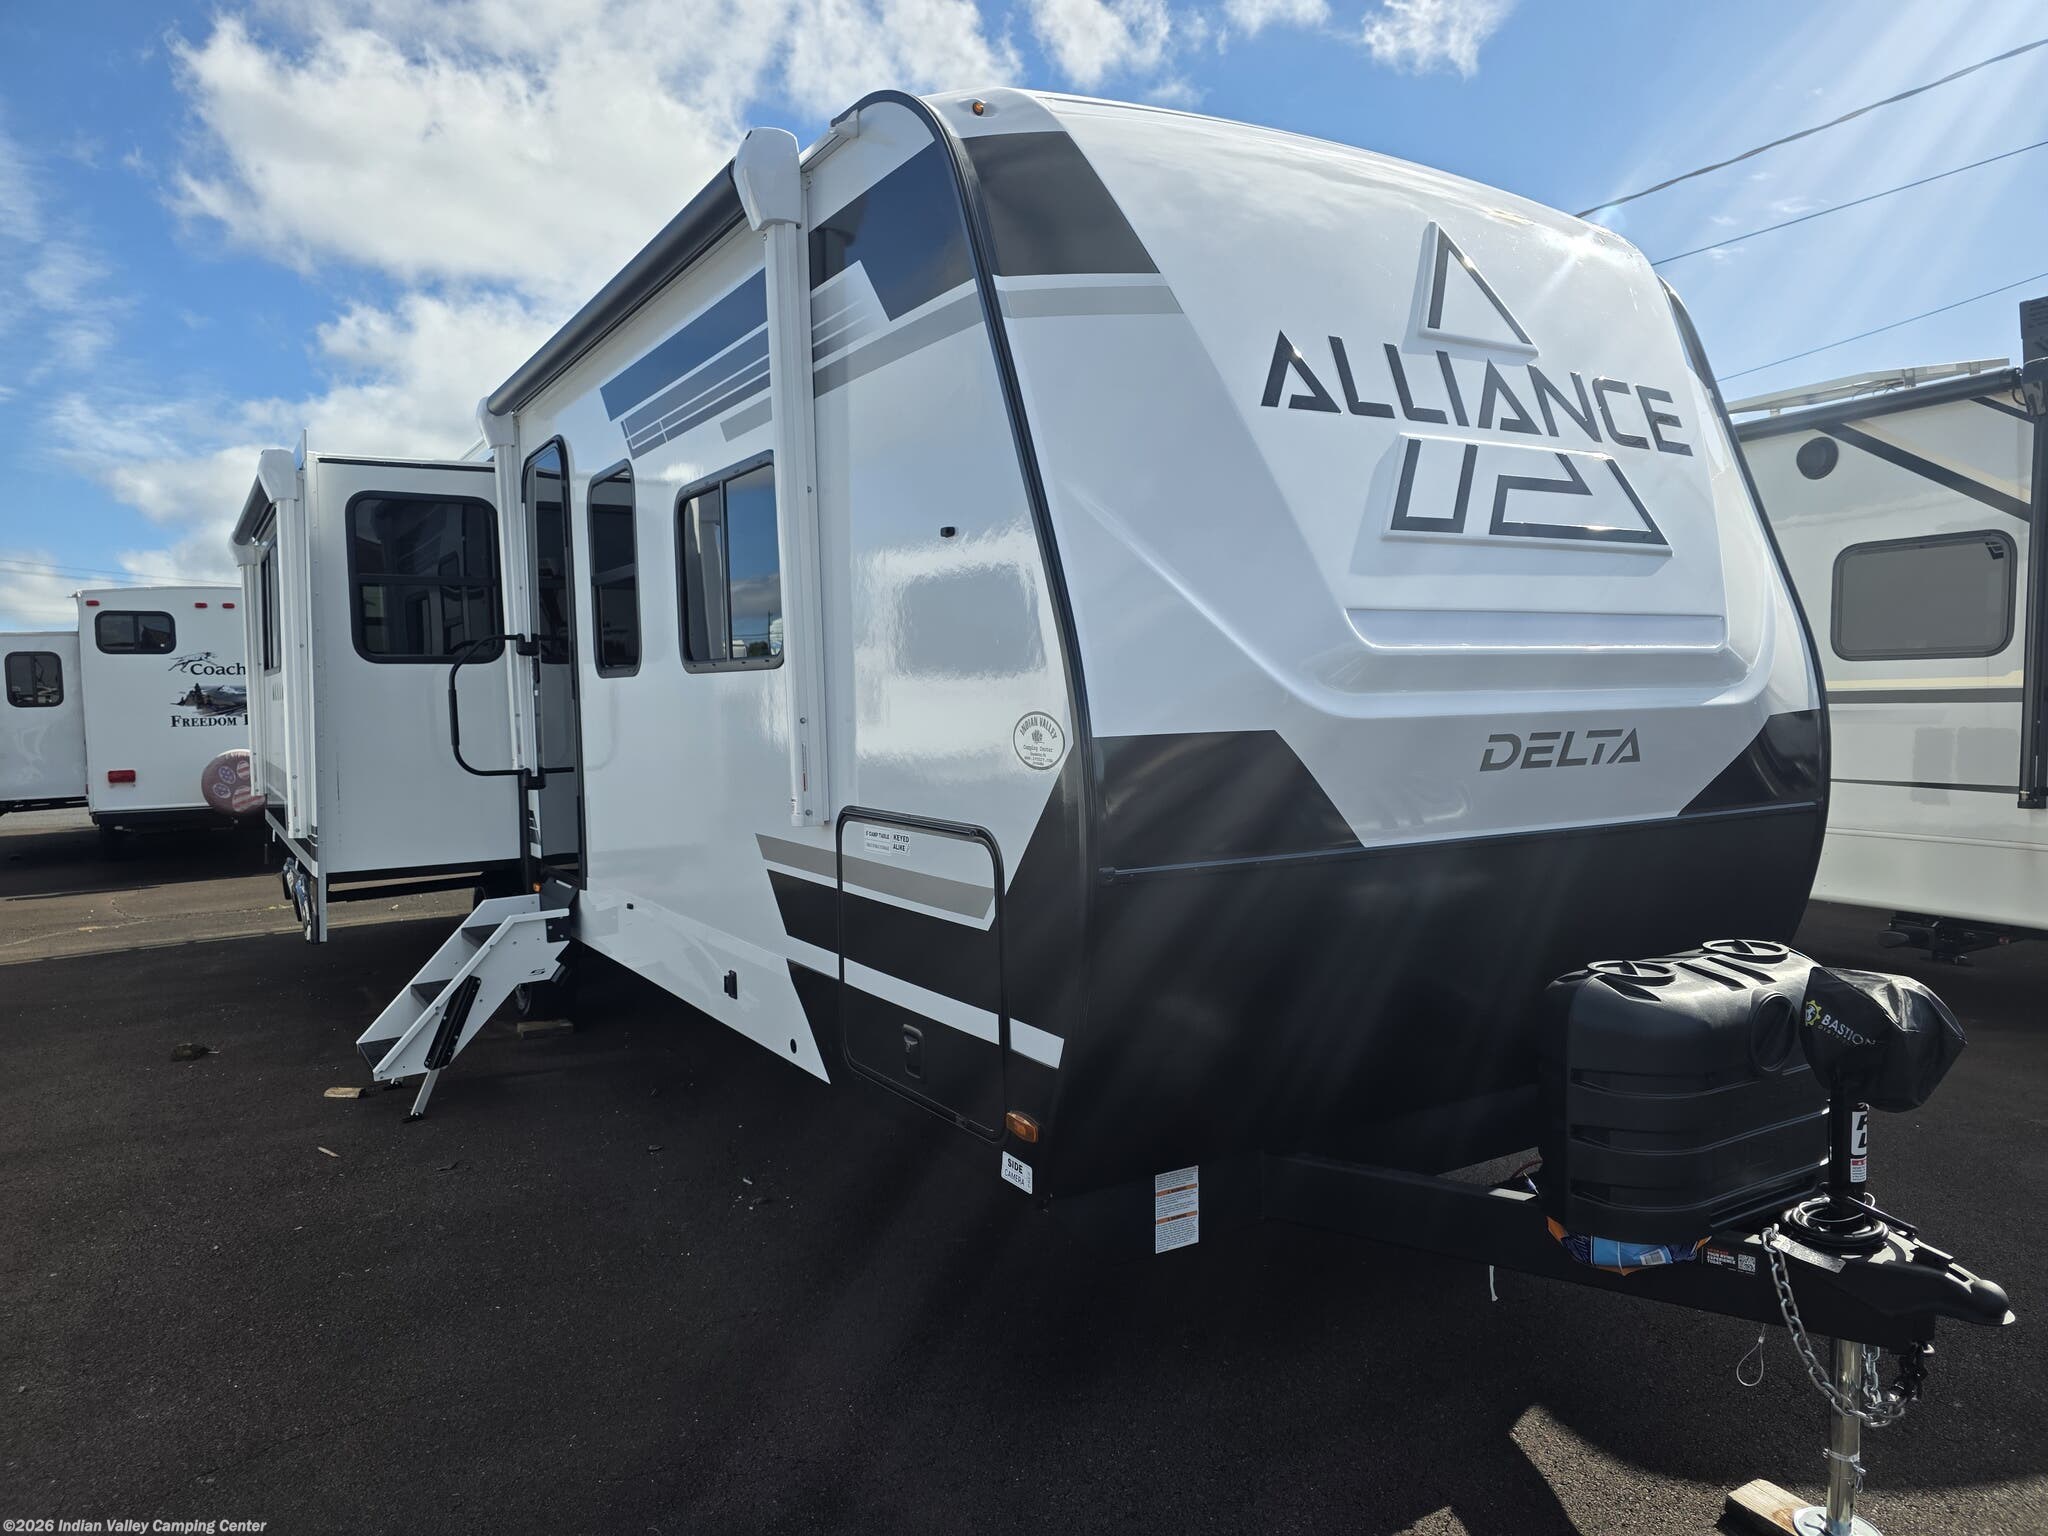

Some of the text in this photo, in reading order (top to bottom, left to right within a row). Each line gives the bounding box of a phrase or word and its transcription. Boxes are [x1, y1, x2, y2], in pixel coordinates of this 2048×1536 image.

[1261, 330, 1693, 456] ALLIANCE
[190, 662, 246, 675] Coach
[170, 715, 237, 727] FREEDOM
[1019, 715, 1057, 739] INDIAN VALLEY
[1479, 728, 1640, 772] DELTA
[893, 834, 910, 843] KEYED
[1007, 1158, 1023, 1175] SIDE
[1004, 1168, 1025, 1187] CAMERA
